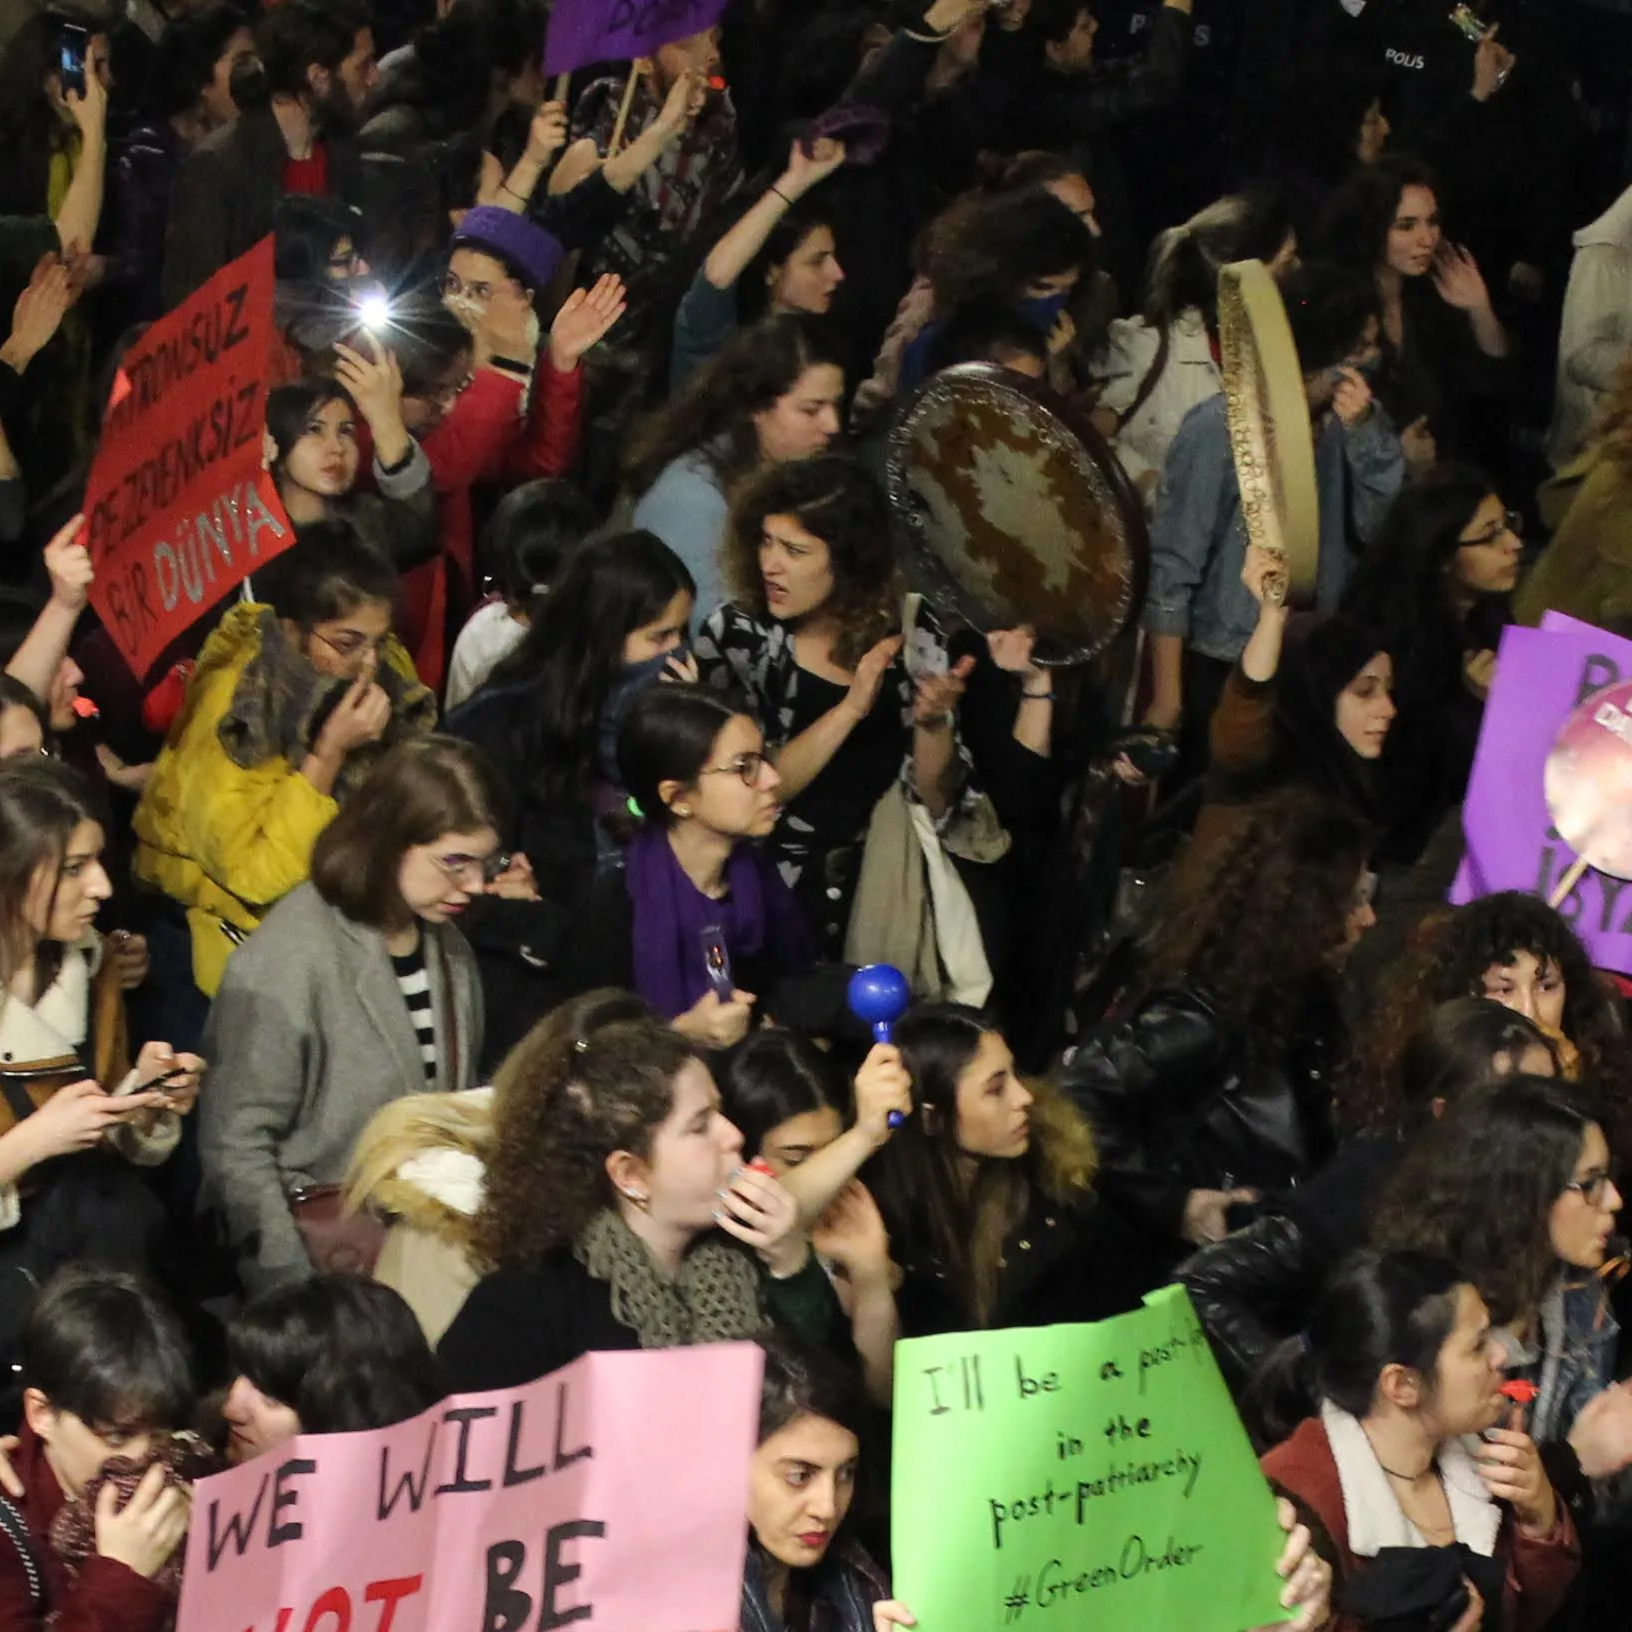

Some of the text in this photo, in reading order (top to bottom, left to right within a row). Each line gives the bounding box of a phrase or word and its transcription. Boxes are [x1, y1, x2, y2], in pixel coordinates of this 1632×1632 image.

[153, 480, 286, 613] DÜNYA
[1015, 1353, 1064, 1399] be
[1099, 1360, 1125, 1382] a
[205, 1381, 594, 1574] WE WILL
[1056, 1414, 1152, 1461] in the
[987, 1450, 1203, 1549] post-patriarchy
[1002, 1534, 1205, 1625] #GreenOrder
